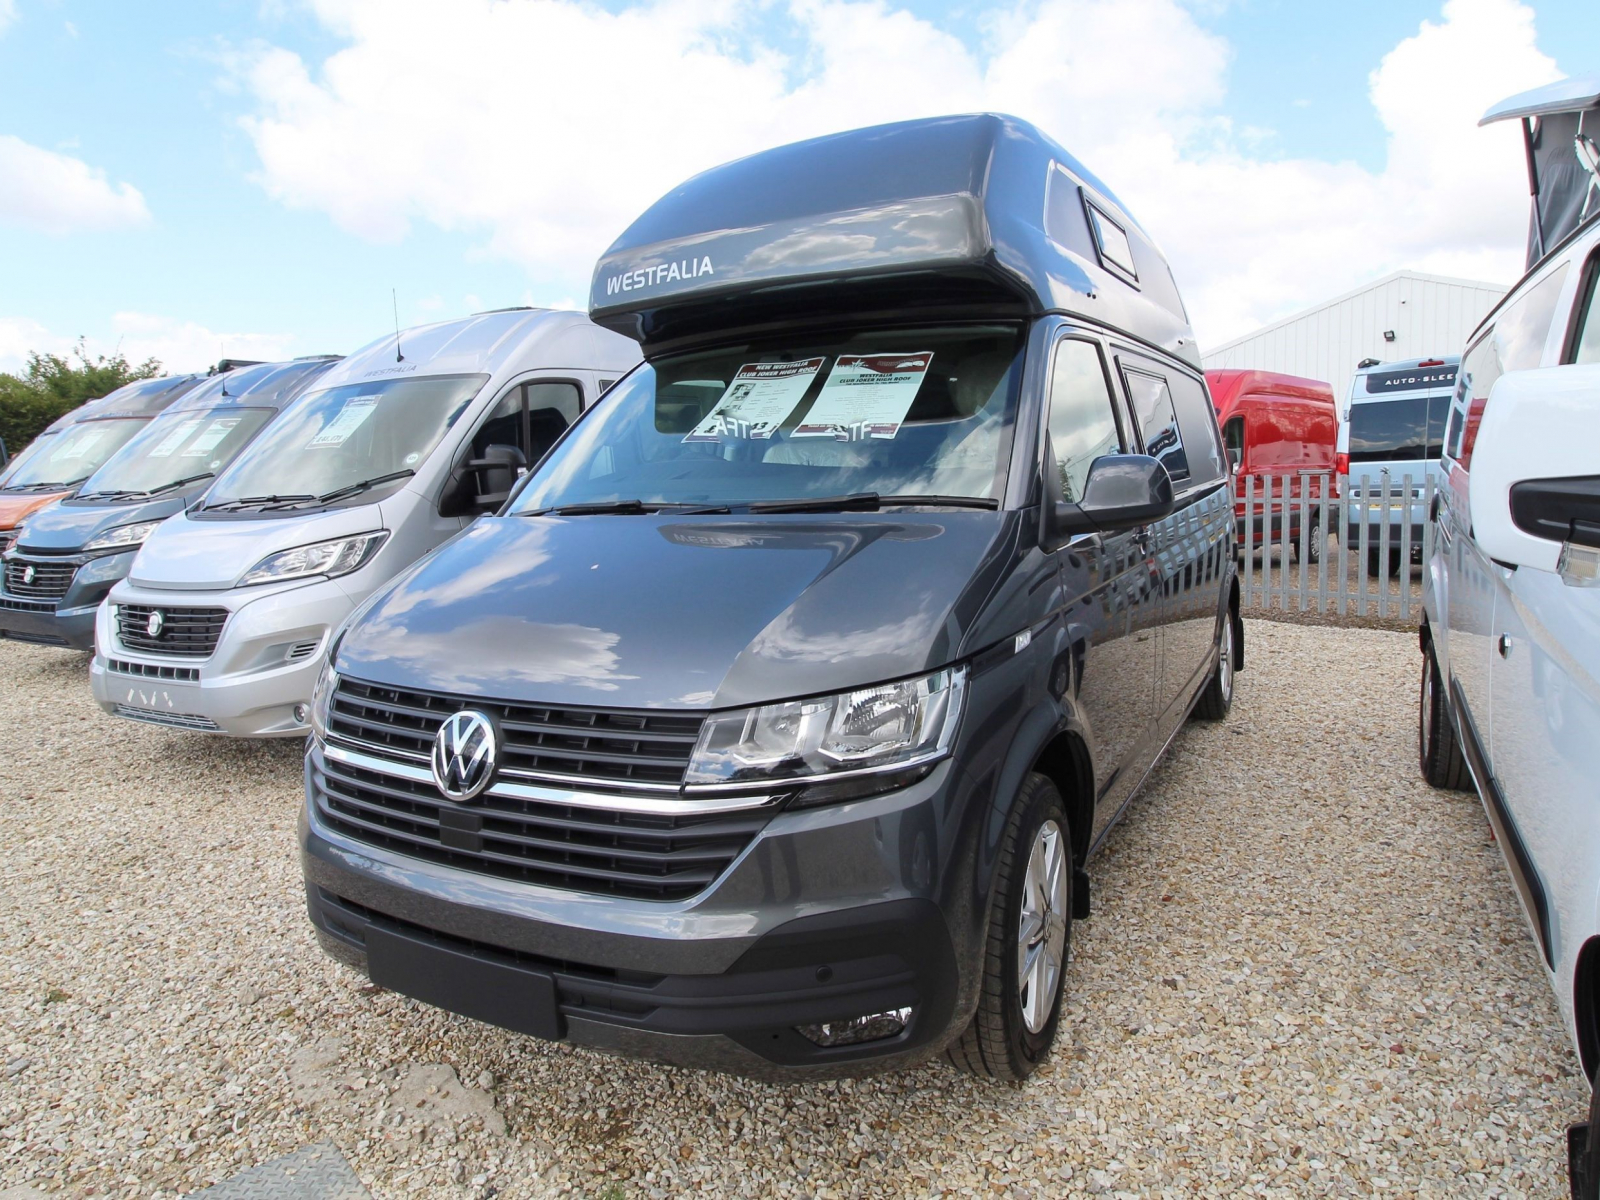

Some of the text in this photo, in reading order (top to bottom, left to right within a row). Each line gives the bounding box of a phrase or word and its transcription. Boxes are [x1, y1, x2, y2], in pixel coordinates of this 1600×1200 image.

[607, 256, 714, 295] WESTFALIA
[364, 365, 418, 377] WESTFALIA
[772, 361, 809, 370] WESTFALIA
[797, 365, 818, 374] ROOF
[1385, 373, 1458, 386] AUTO-SLEE
